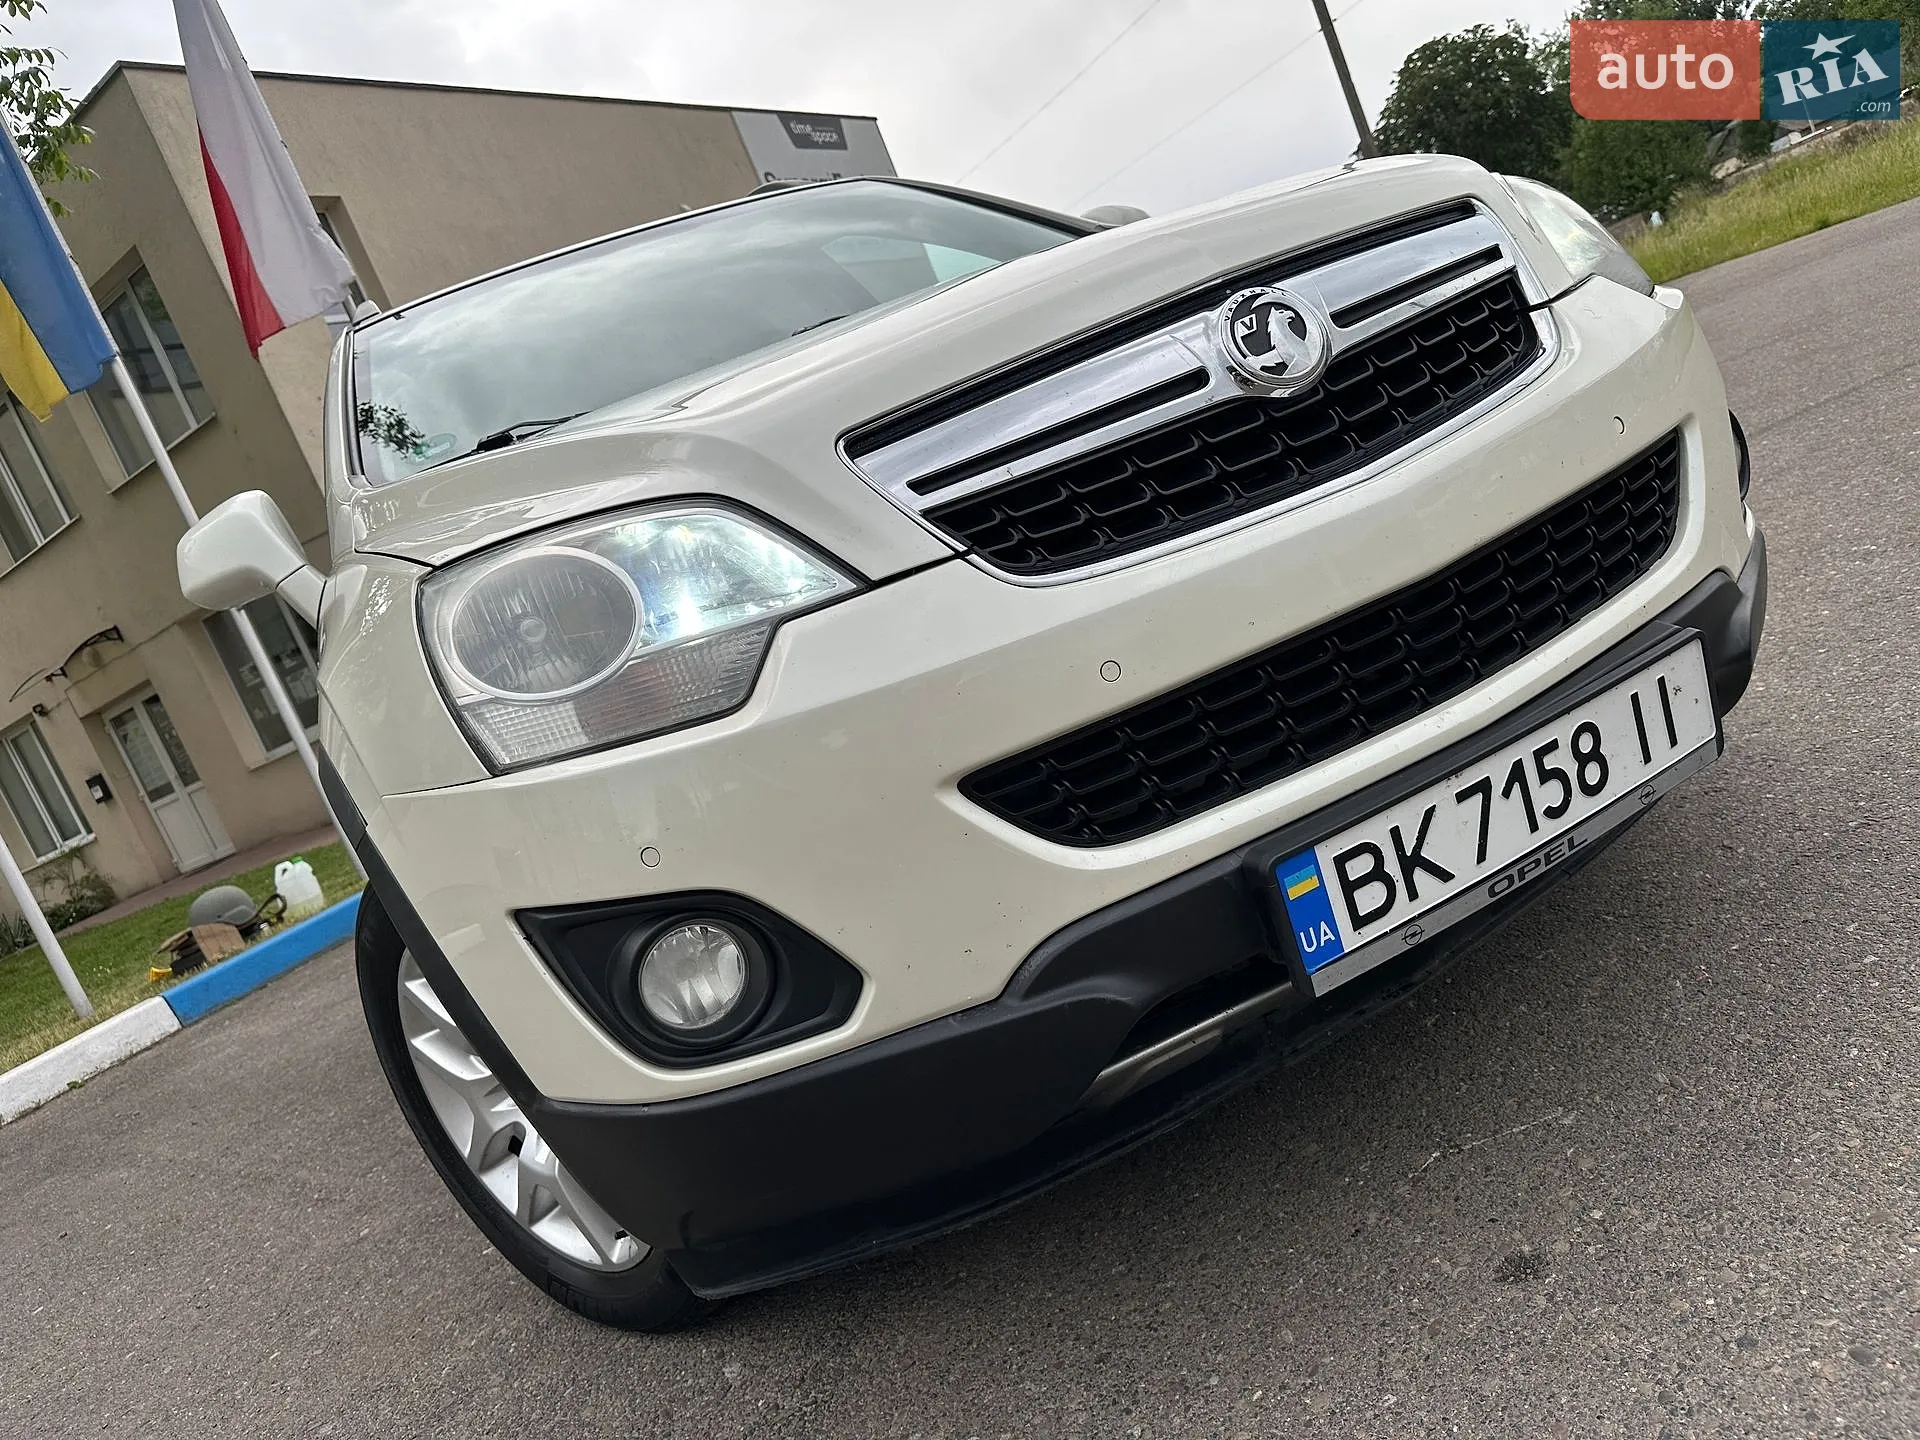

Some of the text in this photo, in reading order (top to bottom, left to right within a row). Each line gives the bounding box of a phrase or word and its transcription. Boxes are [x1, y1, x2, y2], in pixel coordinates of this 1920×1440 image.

[1224, 288, 1287, 322] VAUXHALL
[1333, 675, 1678, 932] BK 7158 II
[1487, 836, 1588, 899] OPEL
[1300, 926, 1336, 954] UA
